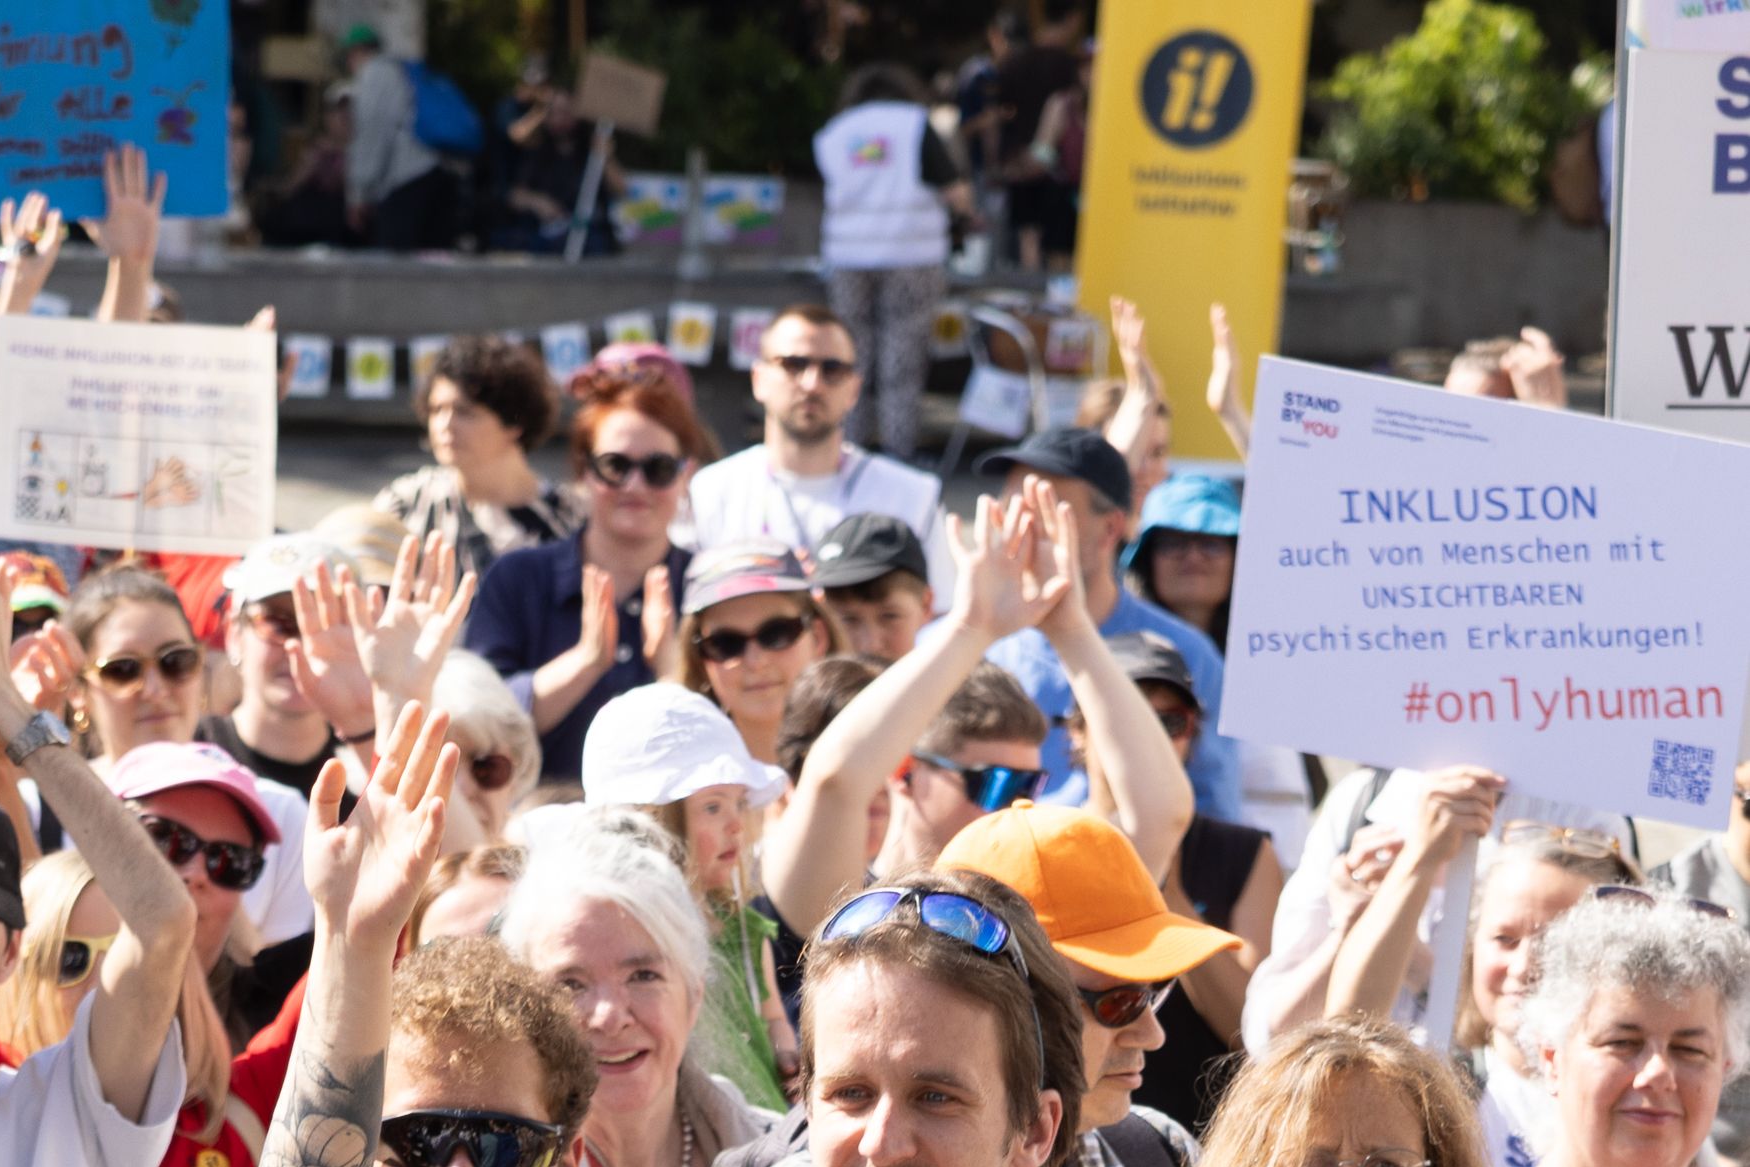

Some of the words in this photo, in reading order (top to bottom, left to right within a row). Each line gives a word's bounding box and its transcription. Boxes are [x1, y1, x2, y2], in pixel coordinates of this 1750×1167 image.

[1281, 408, 1304, 424] BY
[1283, 391, 1341, 414] STAND
[1302, 420, 1340, 440] YOU
[1339, 486, 1599, 524] INKLUSION
[1278, 540, 1350, 567] auch
[1369, 544, 1424, 566] von
[1441, 537, 1591, 564] Menschen
[1608, 535, 1667, 562] mit
[1361, 584, 1585, 608] UNSICHTBAREN
[1249, 624, 1448, 658] psychischen
[1467, 621, 1704, 654] Erkrankungen!
[1403, 676, 1725, 732] #onlyhuman
